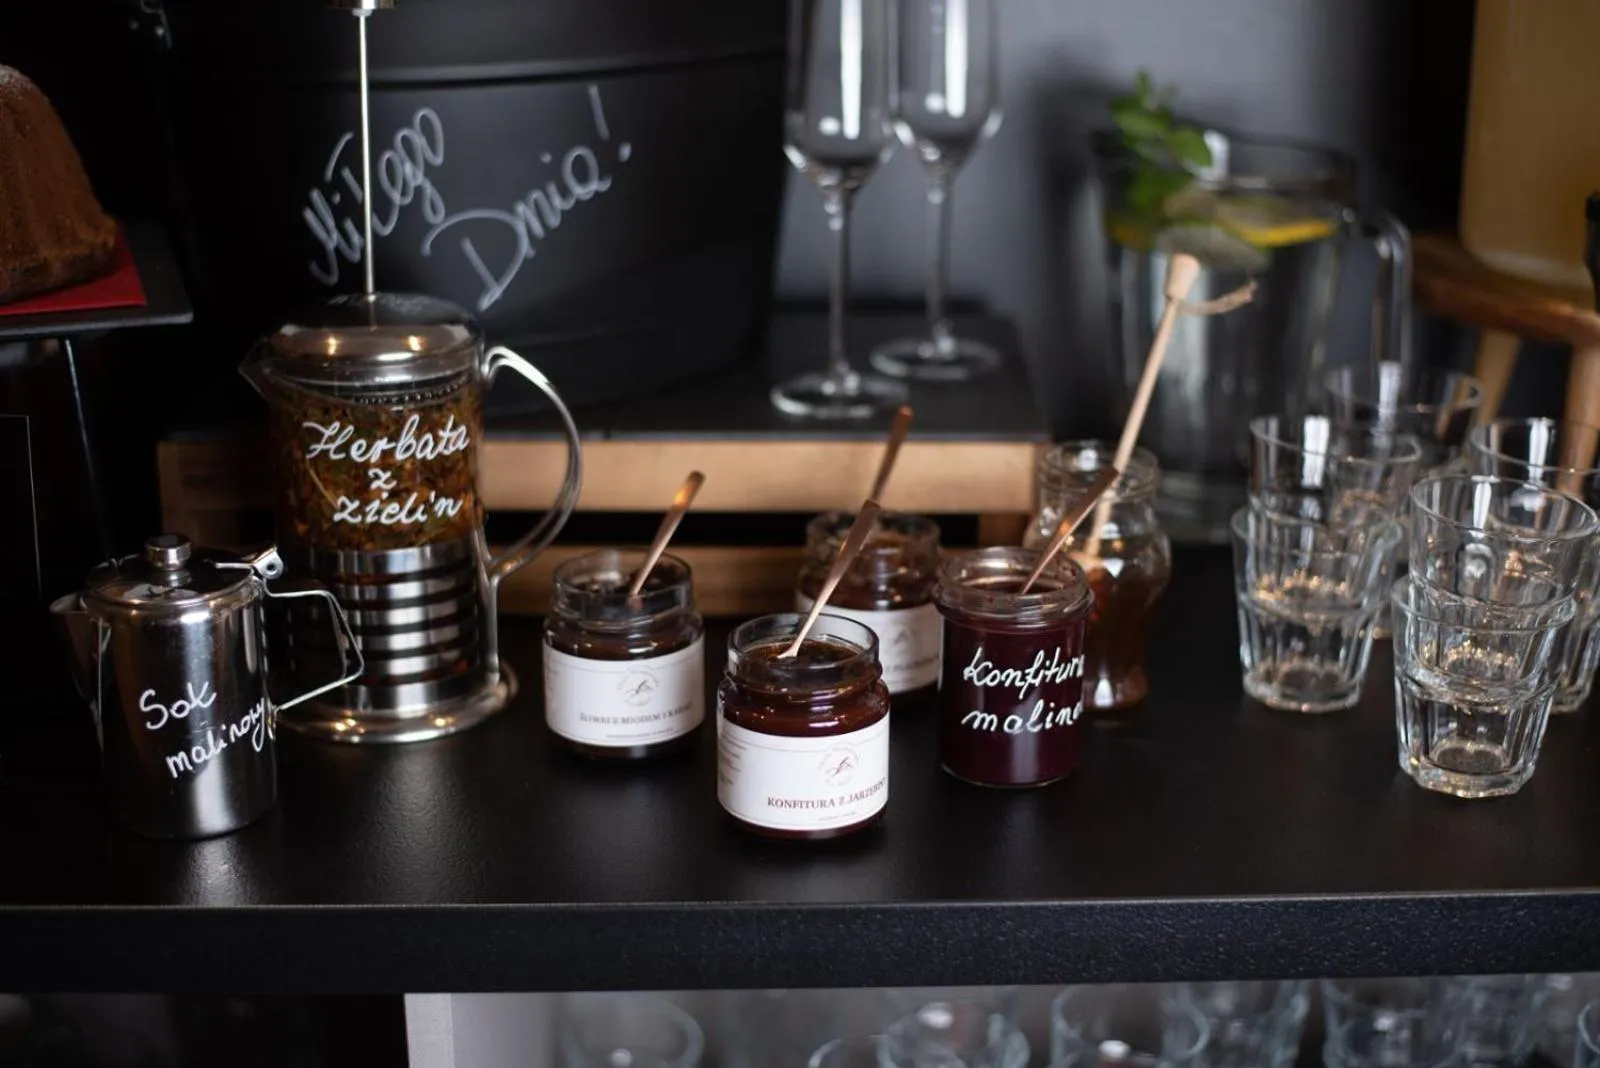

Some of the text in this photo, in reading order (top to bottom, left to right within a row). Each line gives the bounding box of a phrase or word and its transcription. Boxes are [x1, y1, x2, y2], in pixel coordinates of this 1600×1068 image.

[420, 84, 632, 312] Dnia!
[302, 413, 470, 463] Herbata
[139, 681, 218, 730] Sok
[767, 796, 837, 810] KONFITURA
[838, 796, 846, 807] Z
